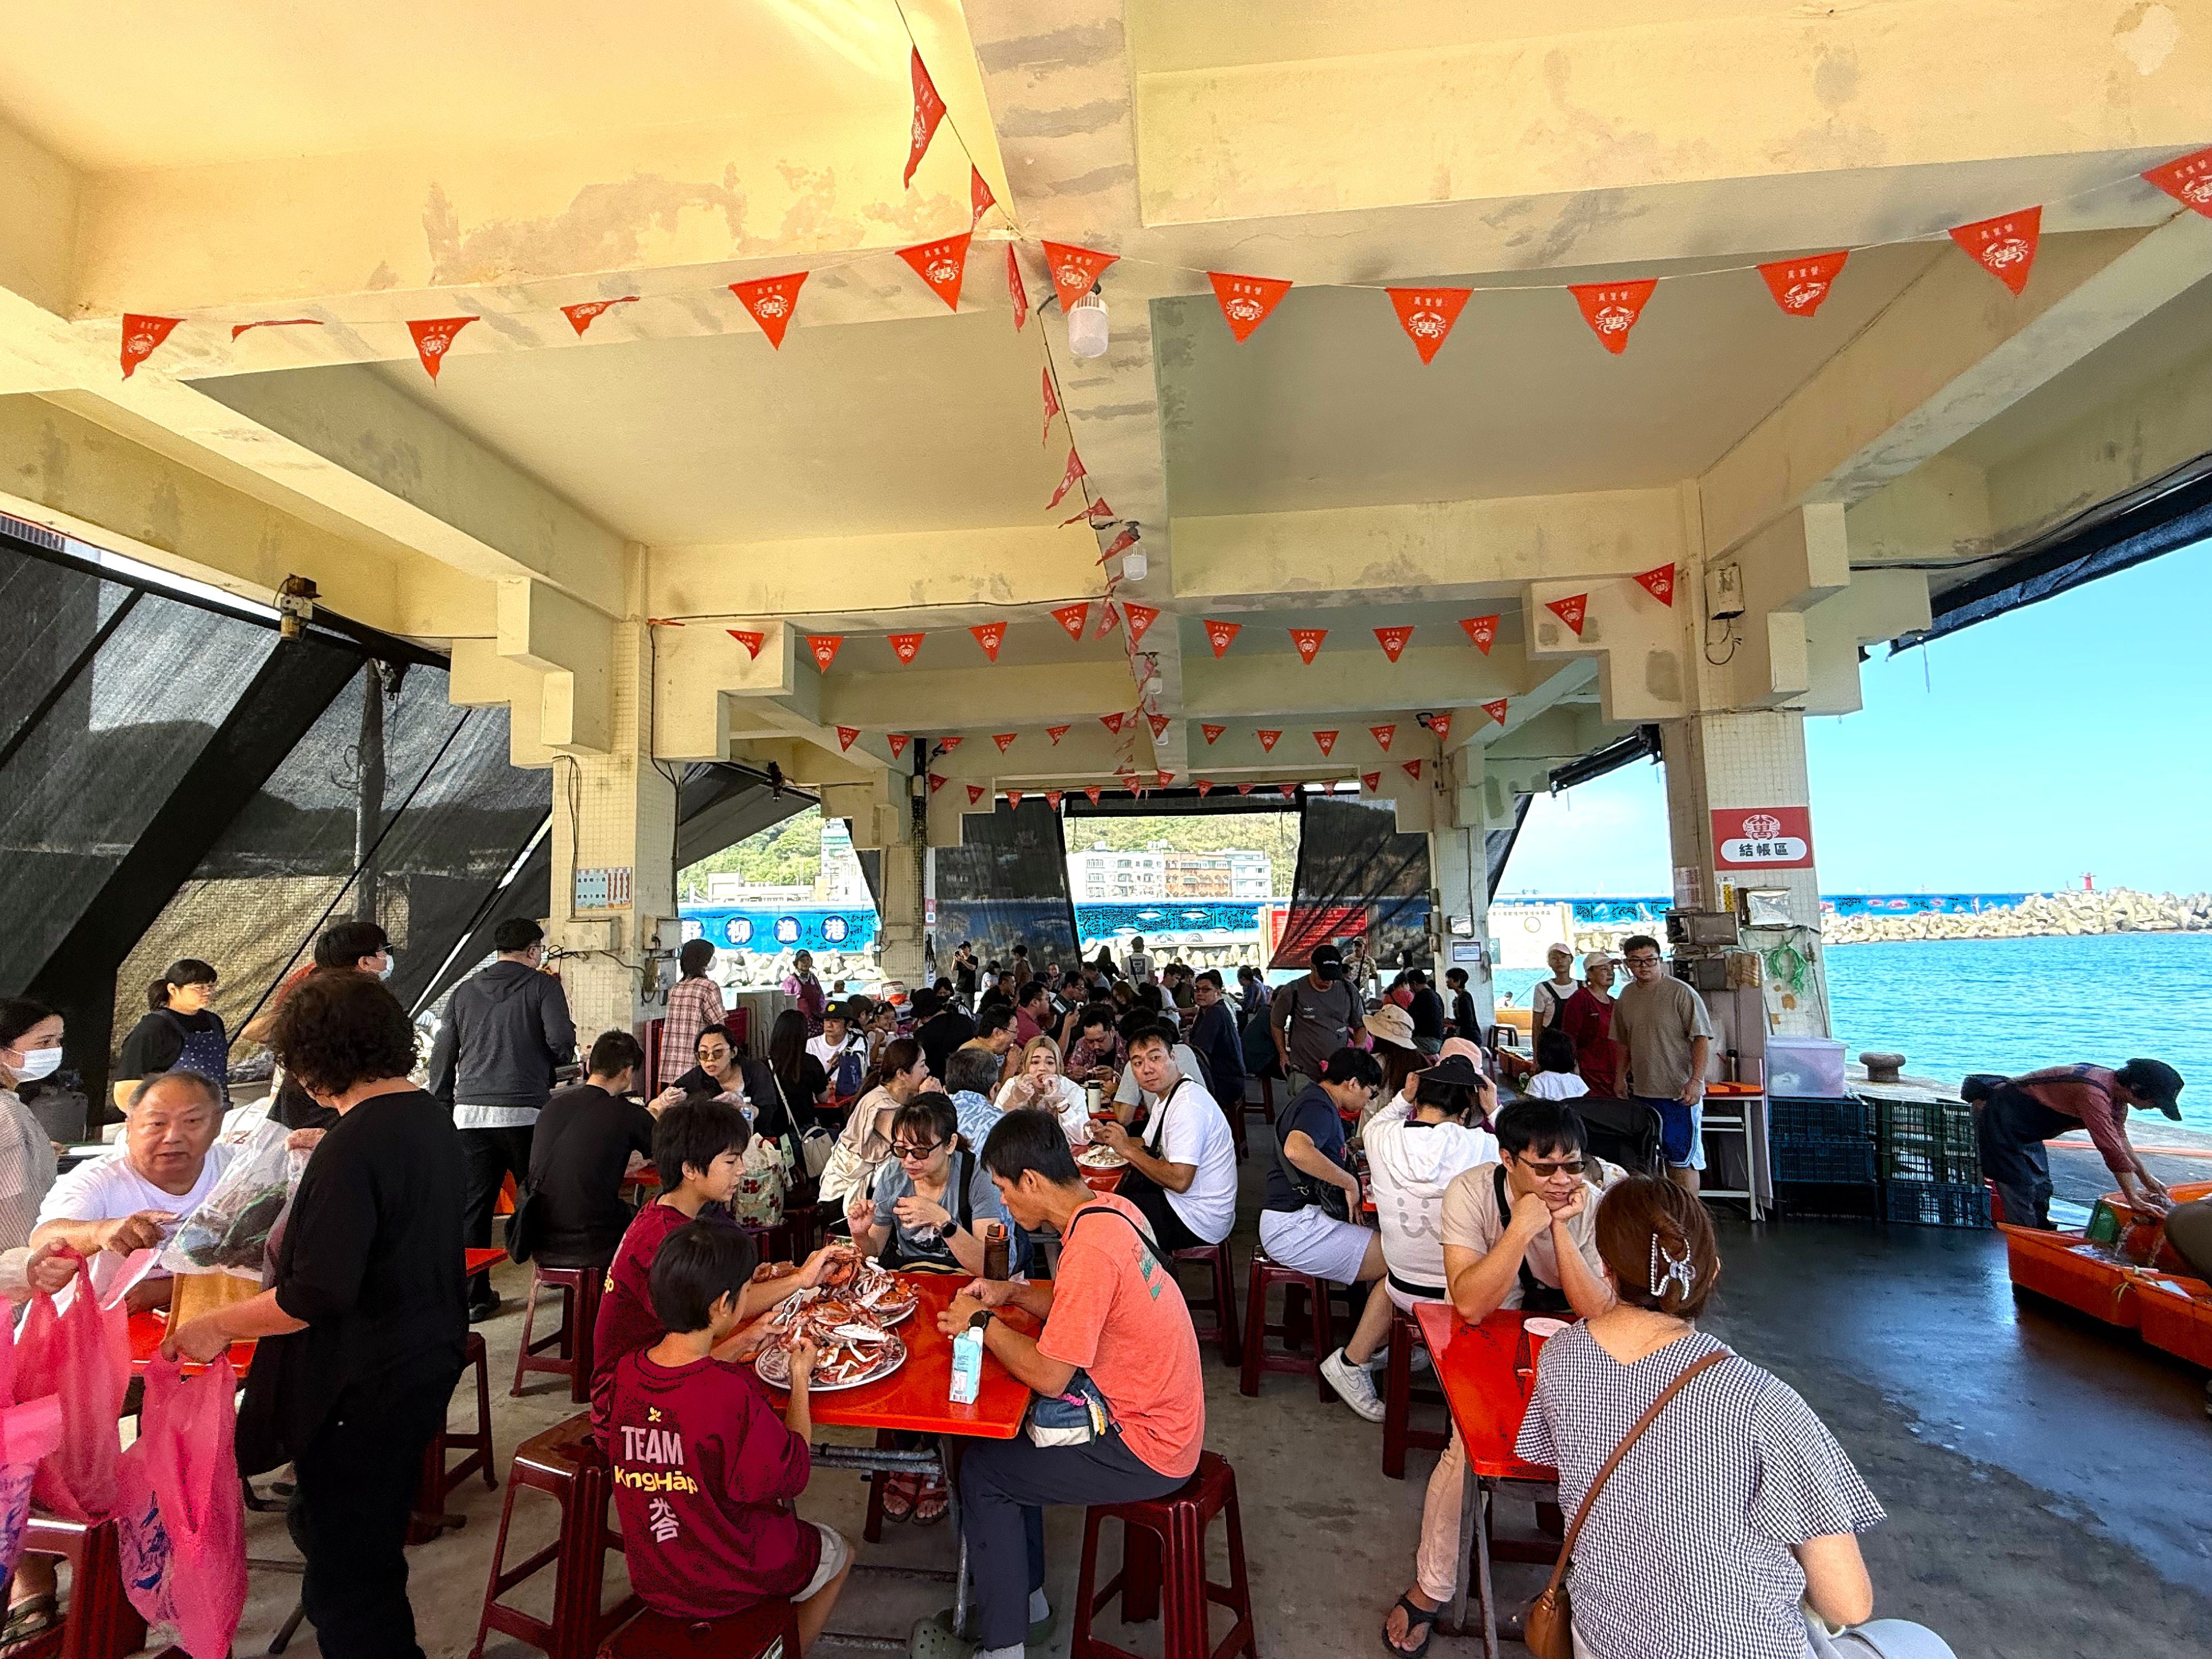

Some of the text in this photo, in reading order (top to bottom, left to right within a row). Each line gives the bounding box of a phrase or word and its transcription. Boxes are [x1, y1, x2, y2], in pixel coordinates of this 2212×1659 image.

[1739, 843, 1789, 857] 結帳區
[681, 918, 846, 944] 野柳漁港
[621, 1426, 684, 1465] TEAM
[649, 1497, 679, 1543] 光合
